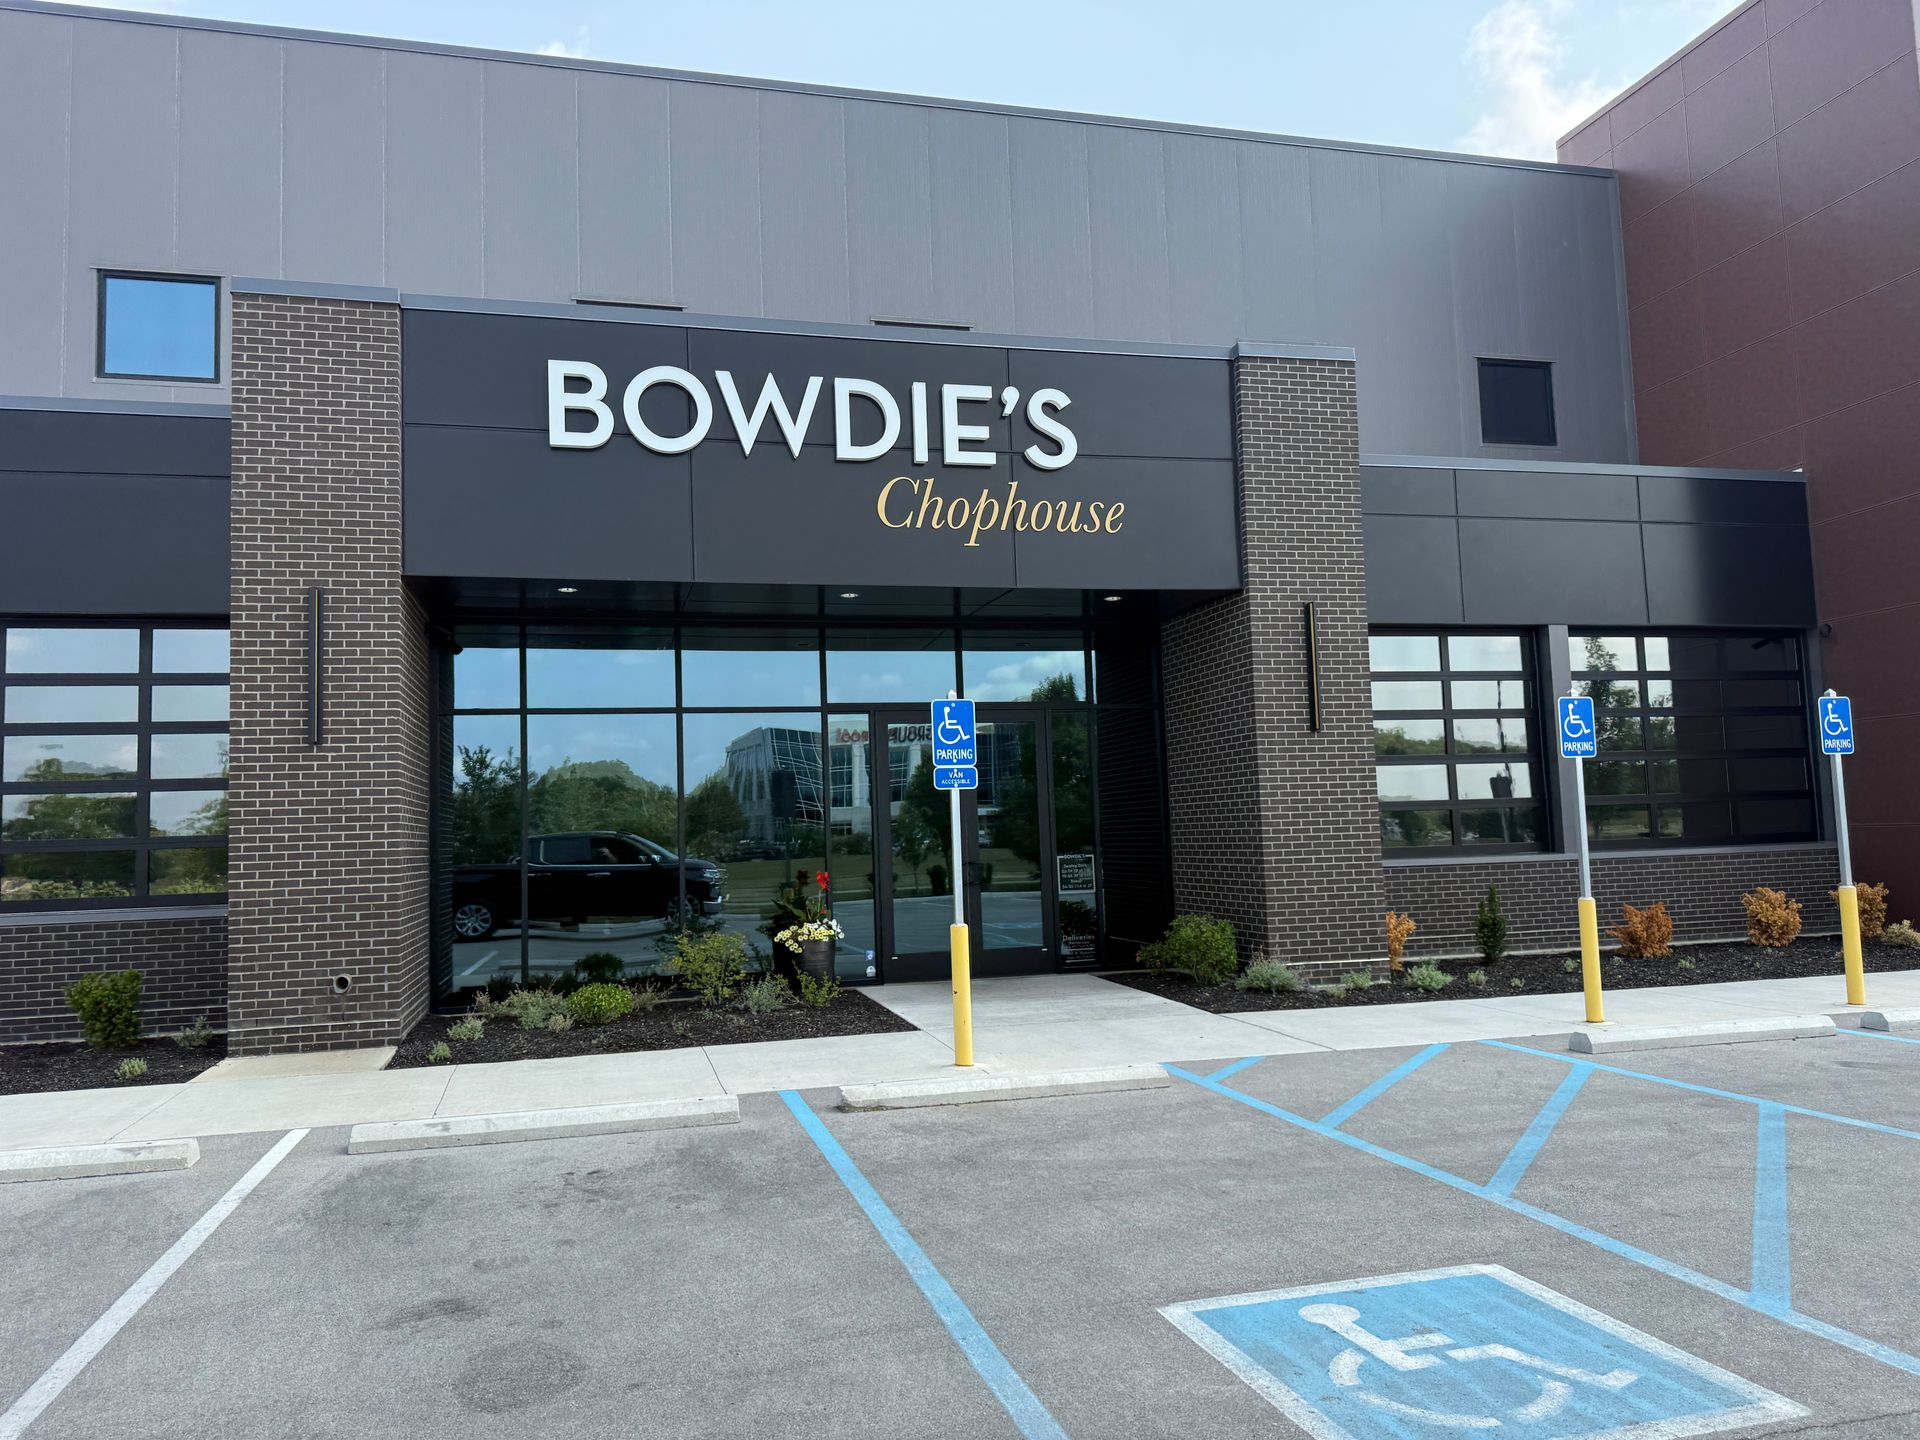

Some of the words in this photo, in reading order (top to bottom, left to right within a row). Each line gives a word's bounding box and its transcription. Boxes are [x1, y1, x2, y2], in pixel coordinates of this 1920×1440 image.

[547, 359, 1079, 470] BOWDIE'S
[877, 476, 1125, 547] Chophouse
[1563, 741, 1594, 752] PARKING
[1825, 739, 1852, 749] PARKING
[936, 748, 973, 760] PARKING
[948, 771, 964, 779] VAN
